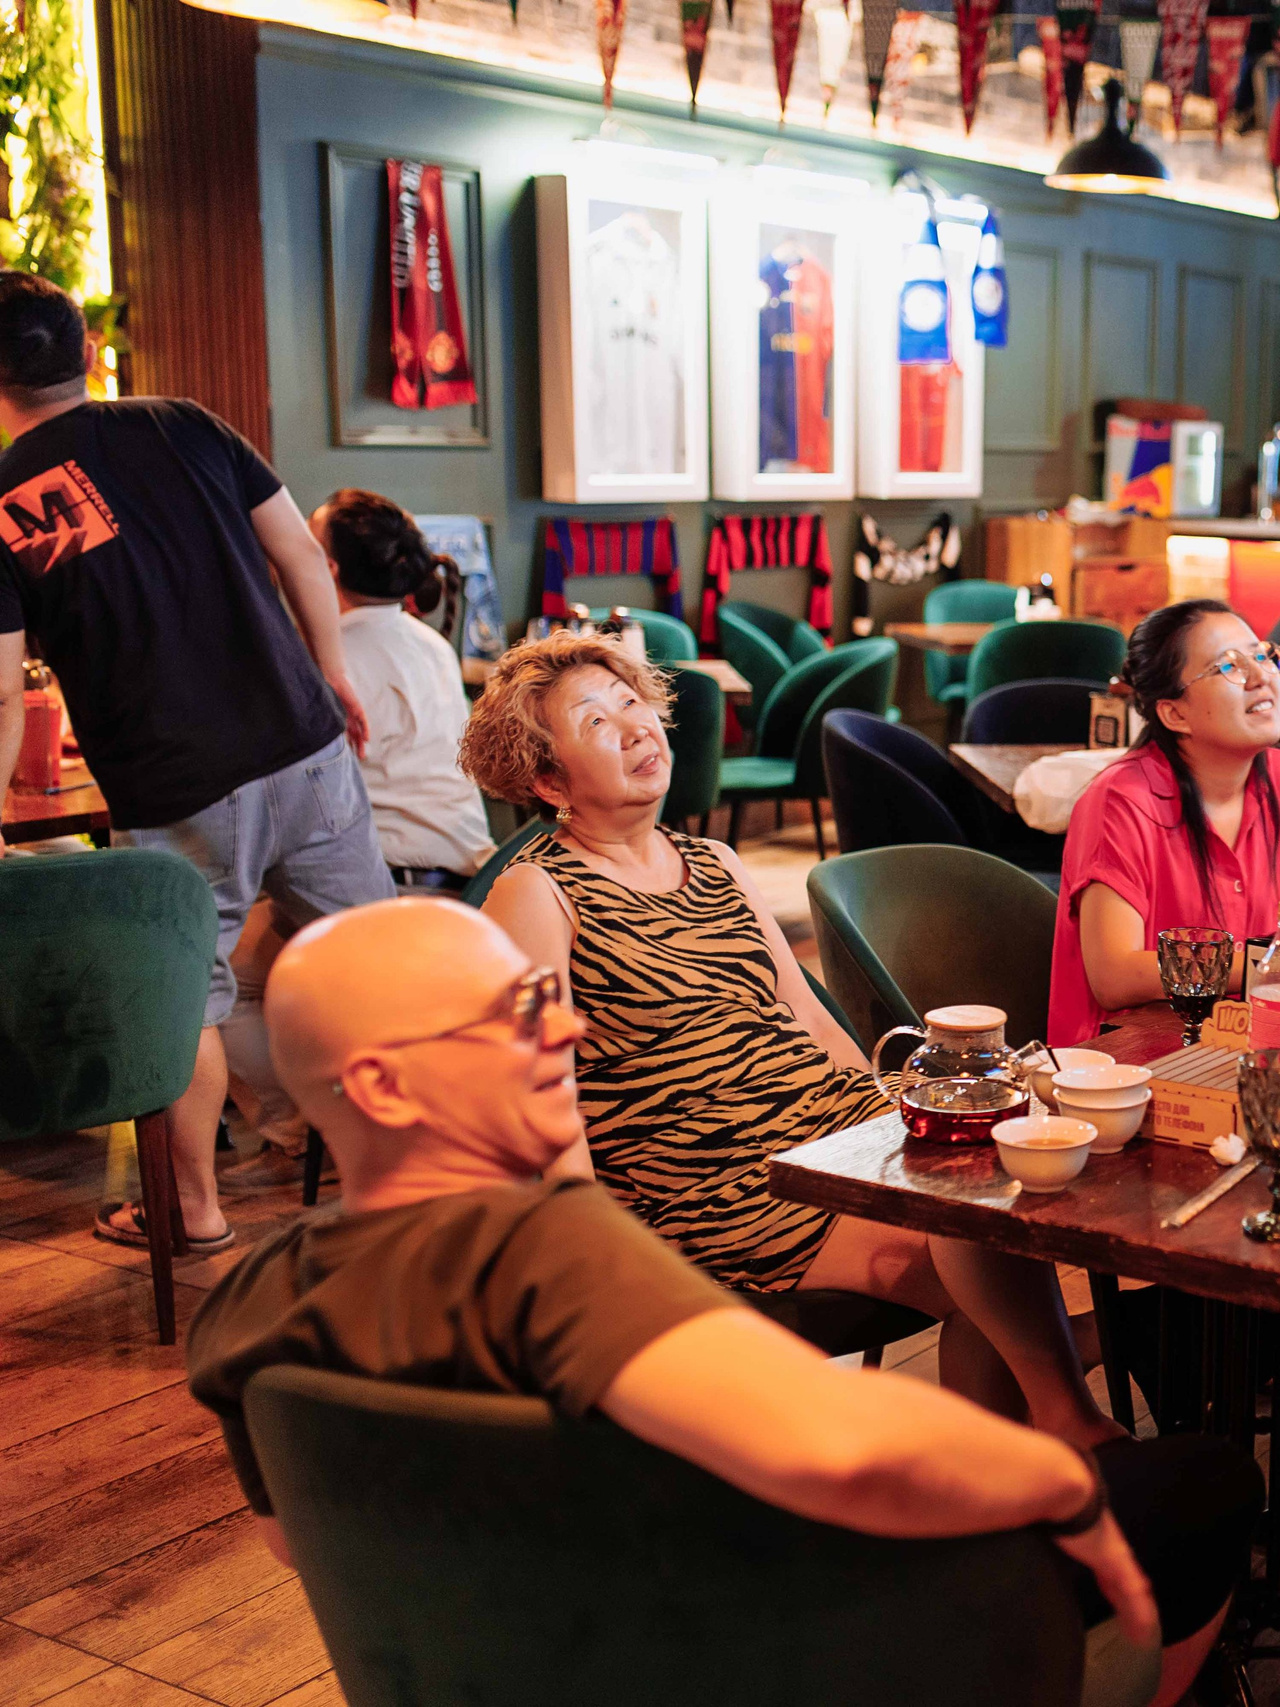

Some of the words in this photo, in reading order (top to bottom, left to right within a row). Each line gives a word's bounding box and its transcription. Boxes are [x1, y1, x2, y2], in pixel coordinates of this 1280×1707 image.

[64, 460, 119, 535] MERRELL
[1217, 1005, 1249, 1034] WO
[1163, 1116, 1206, 1133] ТЕЛЕФОНА
